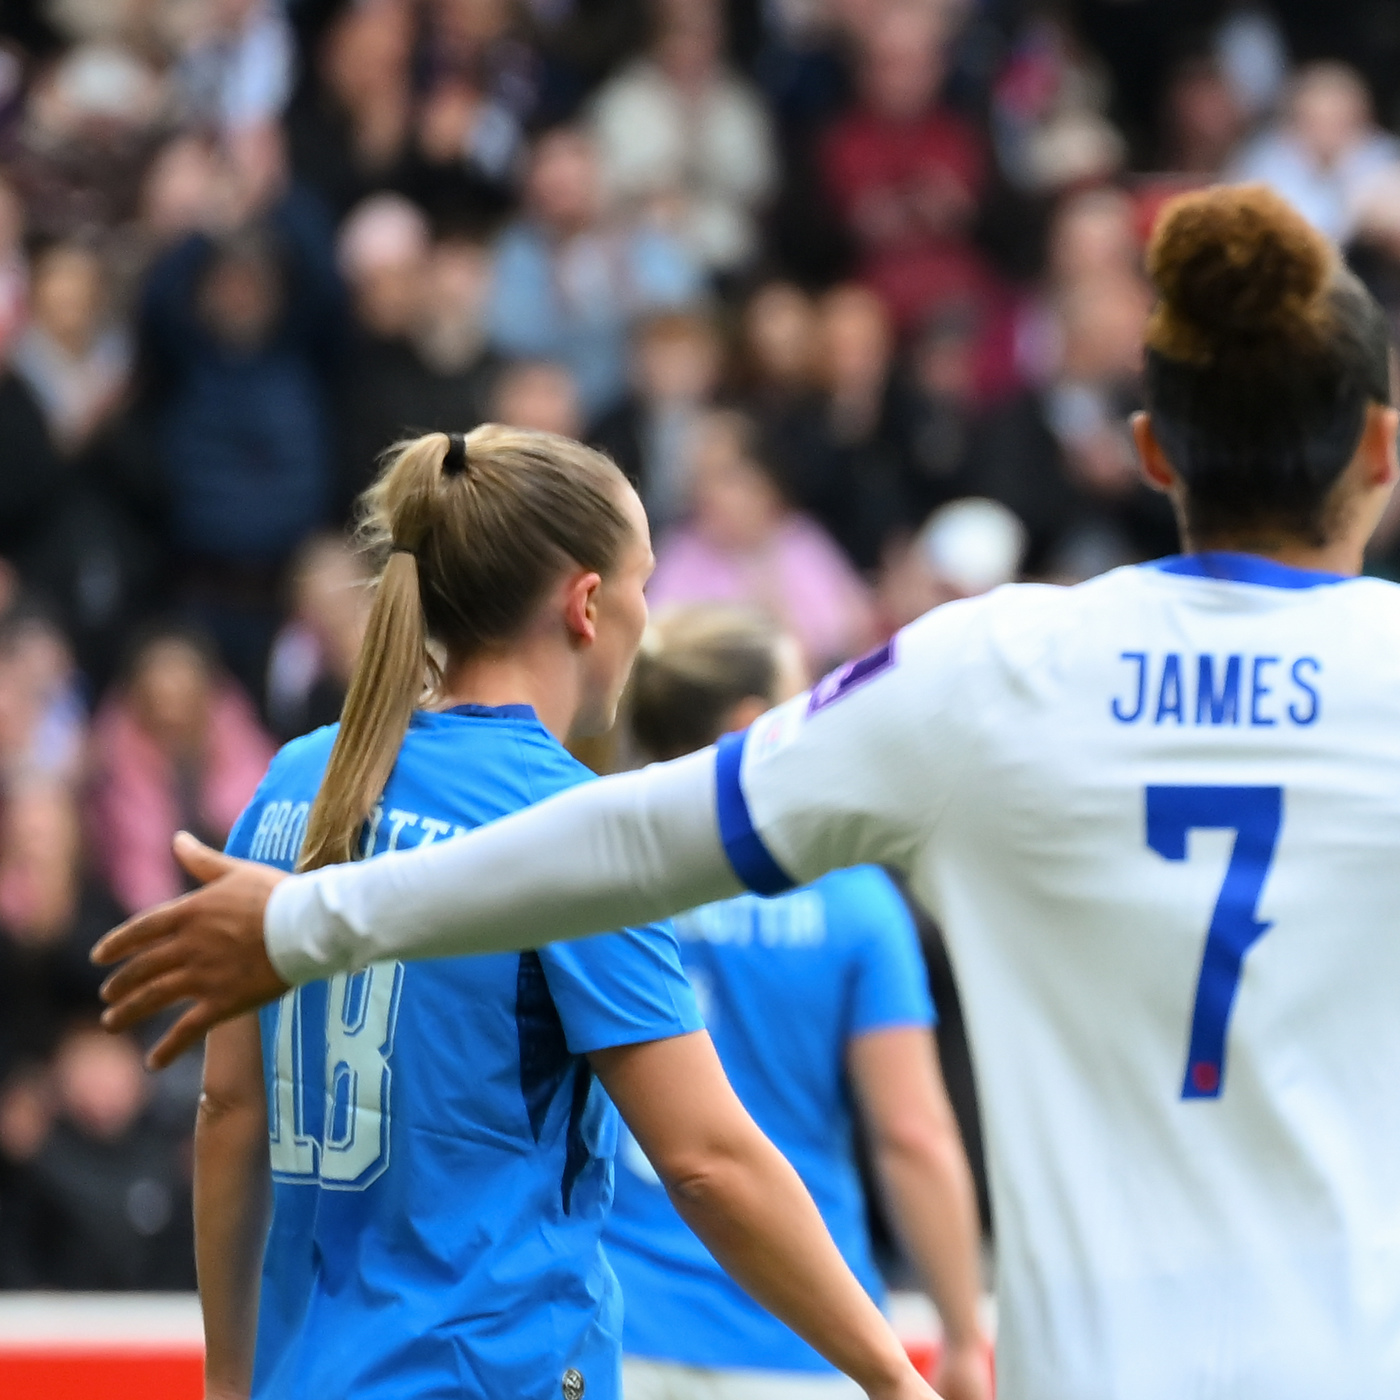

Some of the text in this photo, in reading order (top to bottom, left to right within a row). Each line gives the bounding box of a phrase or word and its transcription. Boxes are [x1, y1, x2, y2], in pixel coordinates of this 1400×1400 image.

[1110, 651, 1323, 727] JAMES
[1145, 785, 1283, 1099] 7
[269, 960, 405, 1192] 18
